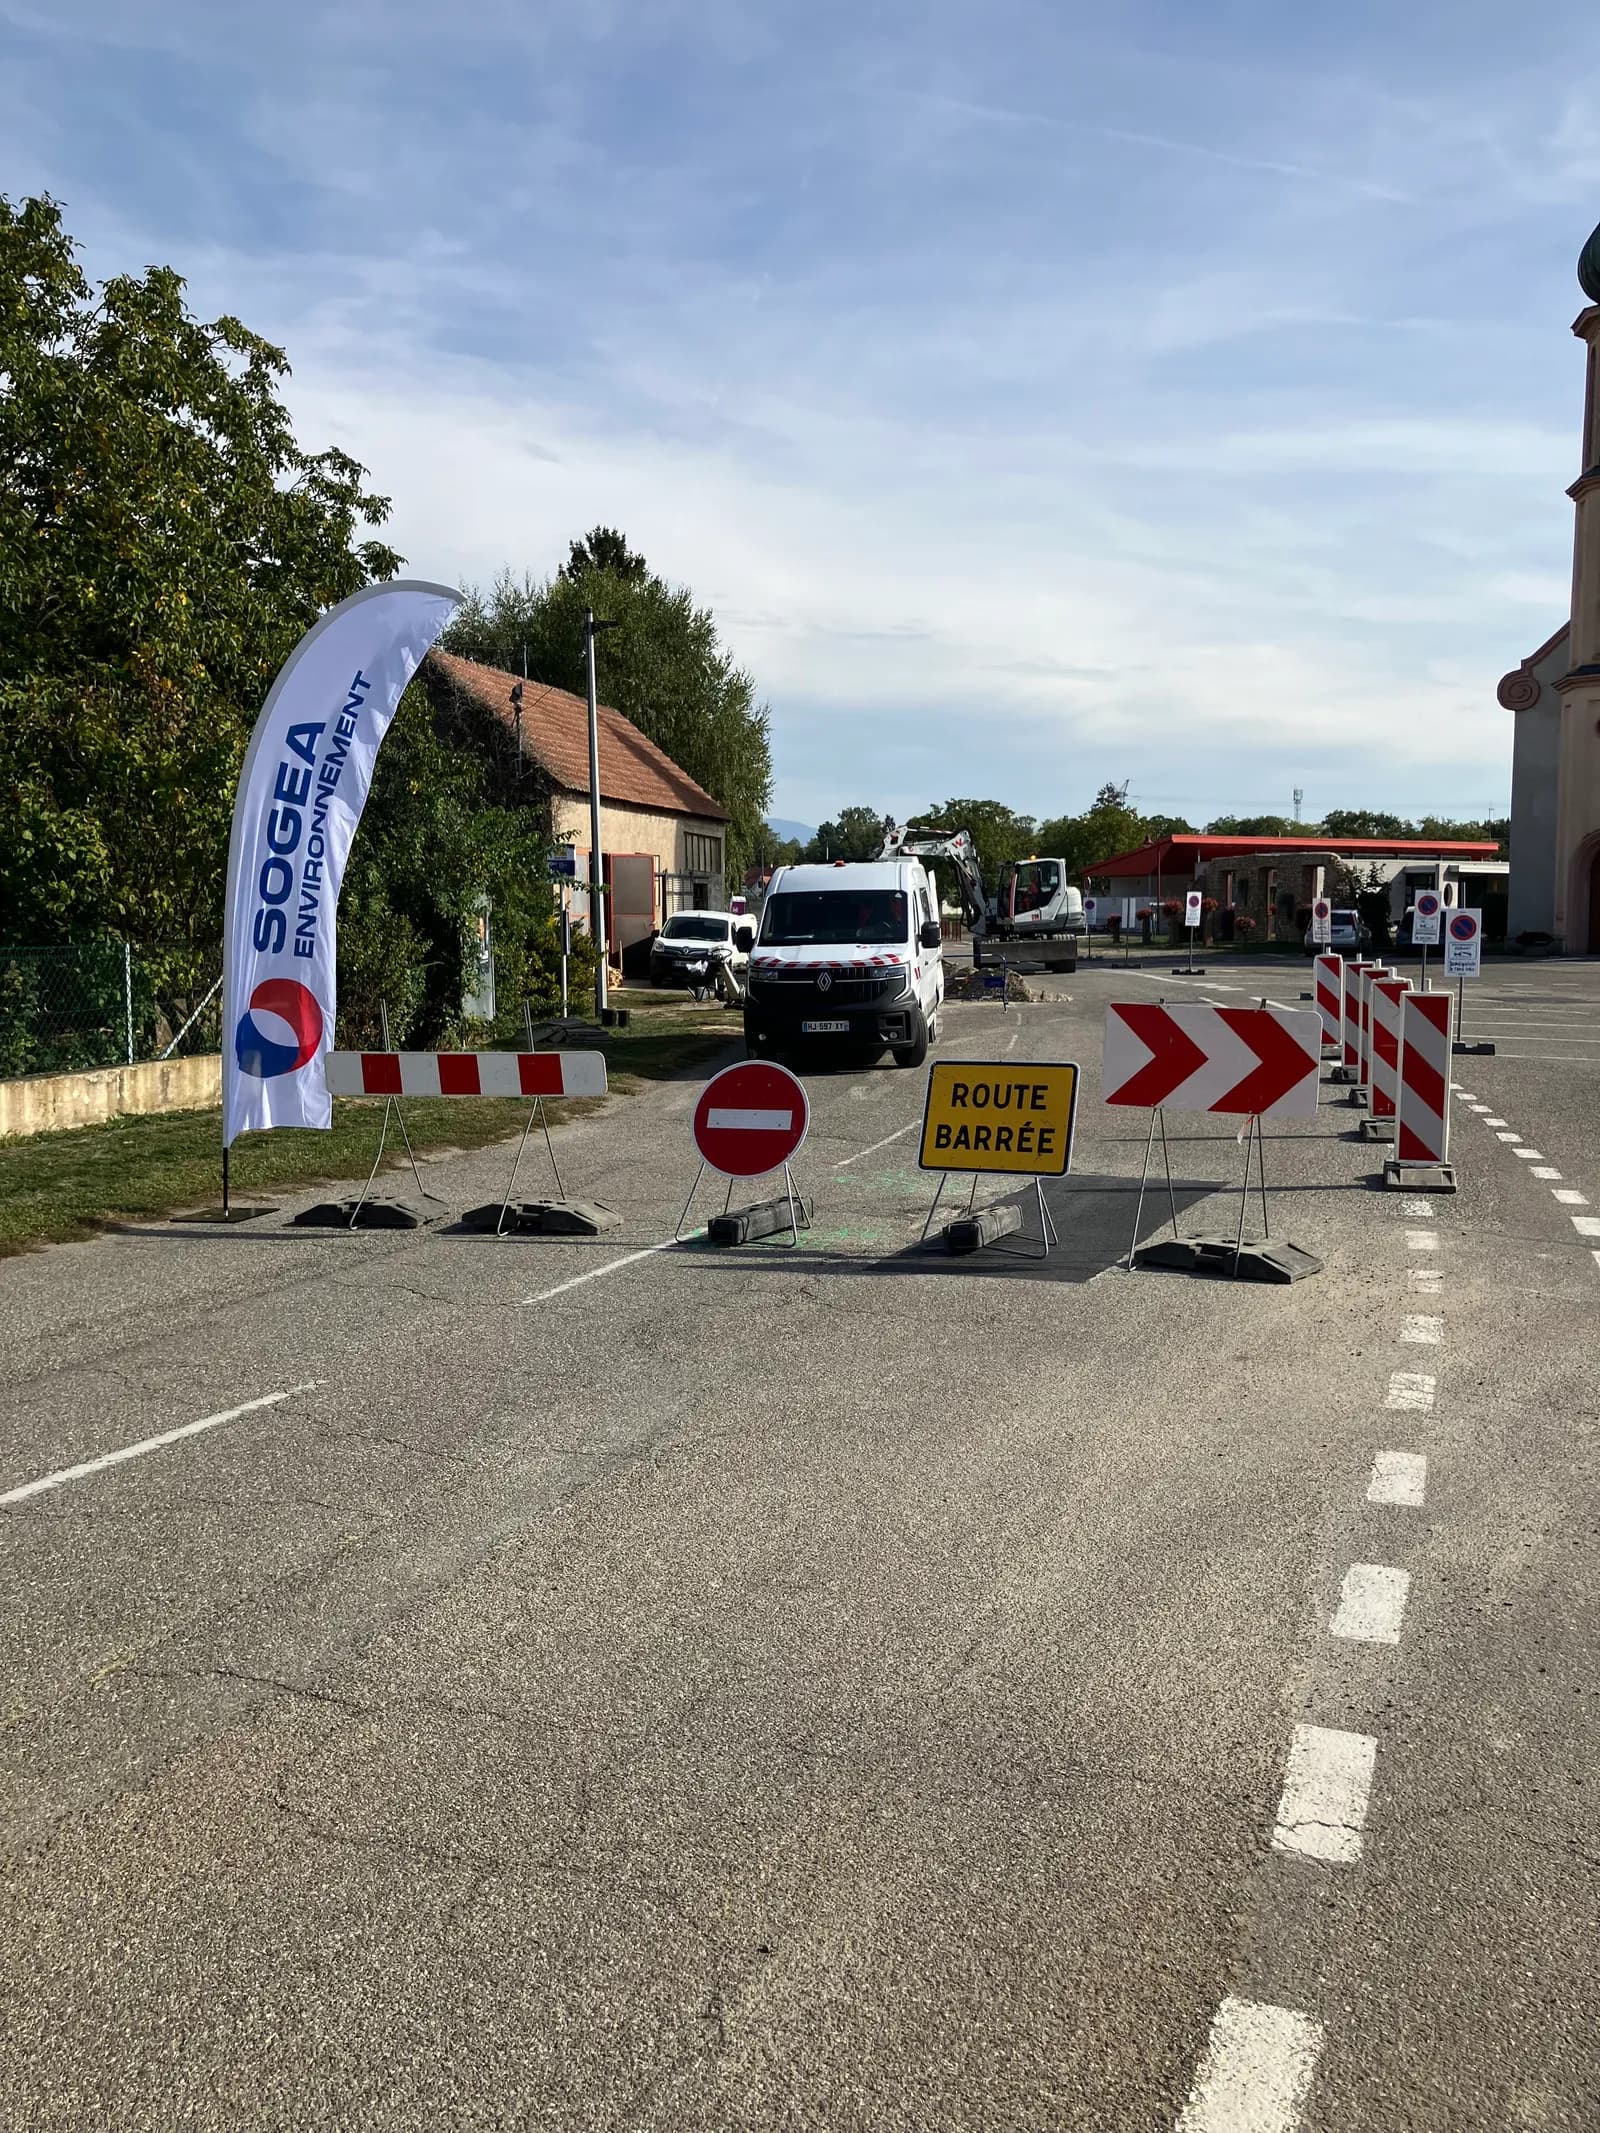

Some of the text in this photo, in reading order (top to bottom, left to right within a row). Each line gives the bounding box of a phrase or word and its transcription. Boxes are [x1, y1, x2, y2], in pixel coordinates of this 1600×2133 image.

[254, 721, 326, 954] SOGEA
[295, 670, 372, 958] ENVIRONNEMENT
[935, 1121, 1056, 1154] BARRÉE
[952, 1083, 1049, 1110] ROUTE
